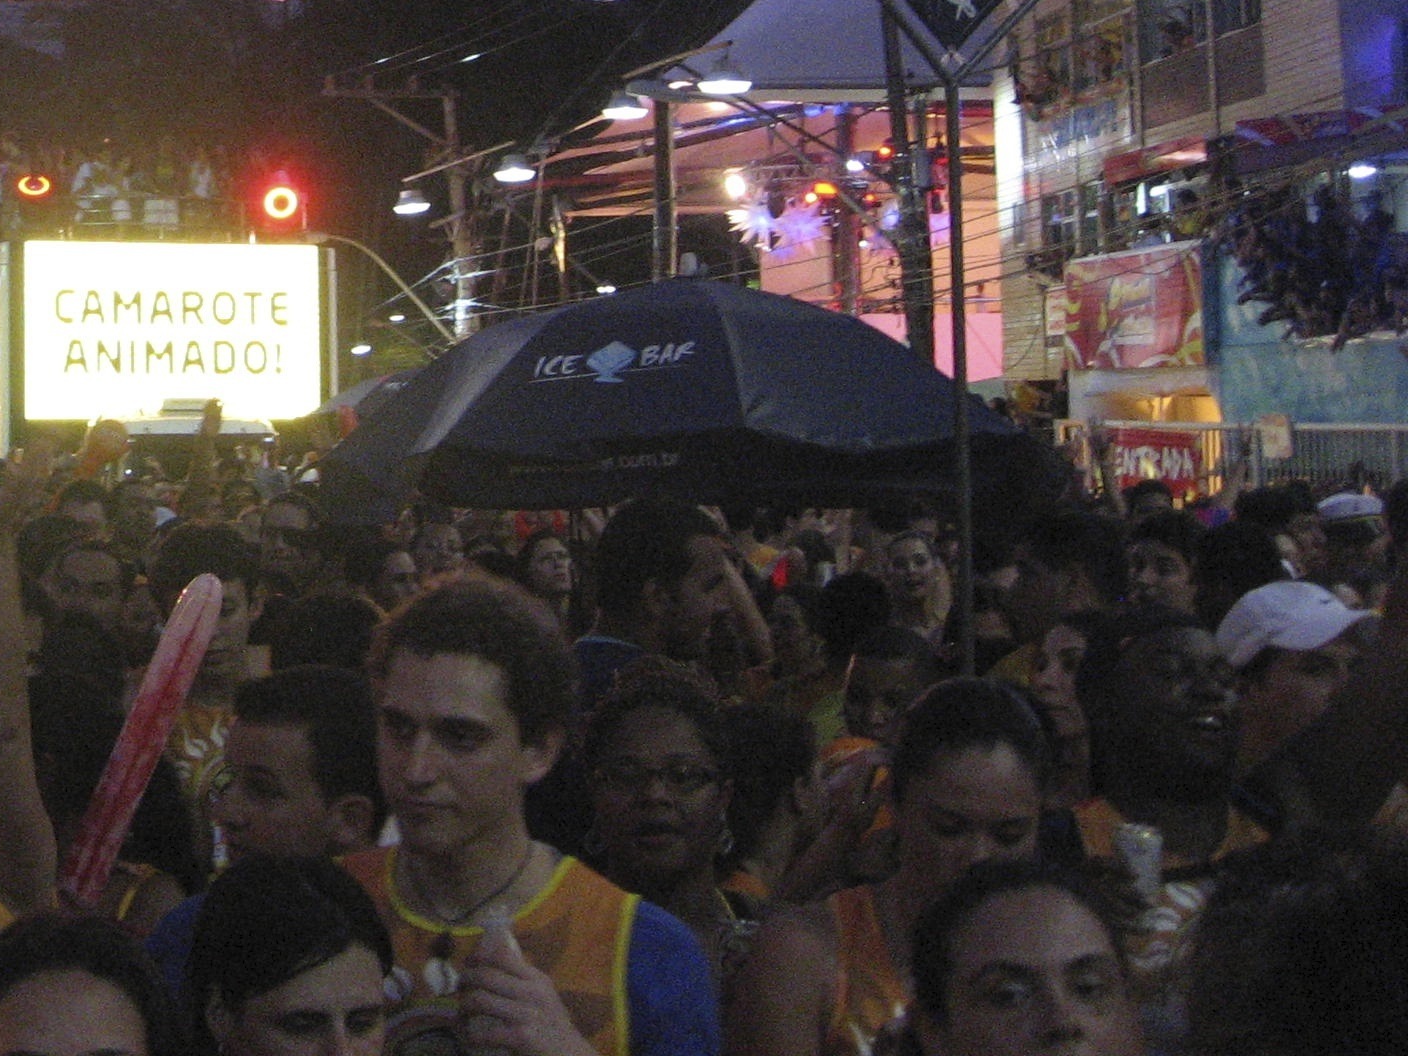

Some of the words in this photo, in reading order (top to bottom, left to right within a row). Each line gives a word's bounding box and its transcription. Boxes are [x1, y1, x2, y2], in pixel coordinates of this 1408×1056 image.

[55, 289, 288, 325] CAMAROTE
[64, 340, 282, 374] ANIMADO!
[533, 352, 584, 378] ICE
